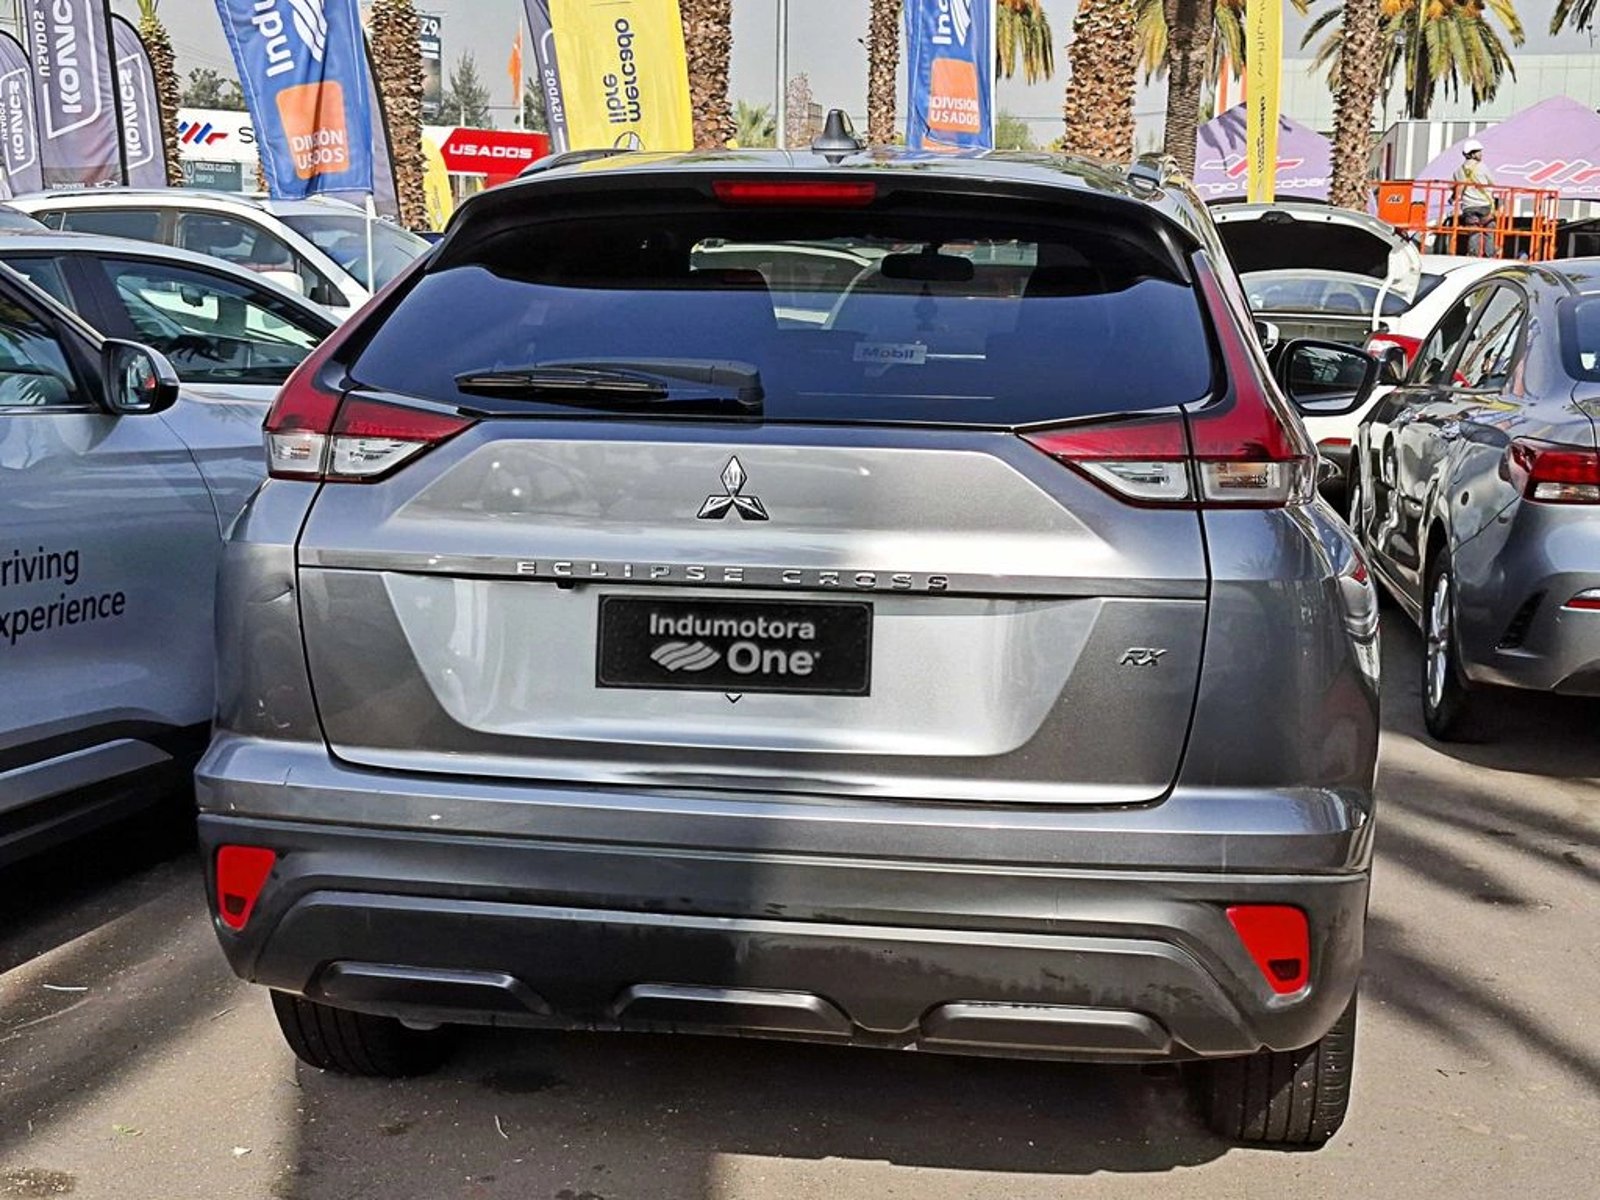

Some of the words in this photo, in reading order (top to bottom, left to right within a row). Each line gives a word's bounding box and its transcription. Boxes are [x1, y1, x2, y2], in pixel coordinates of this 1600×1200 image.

[931, 109, 979, 126] USADOS
[449, 143, 534, 159] USADOS
[517, 561, 744, 582] ECLIPSE
[781, 569, 949, 590] CROSS
[649, 613, 816, 639] Indumotora
[727, 641, 814, 675] One
[1119, 647, 1168, 666] RX
